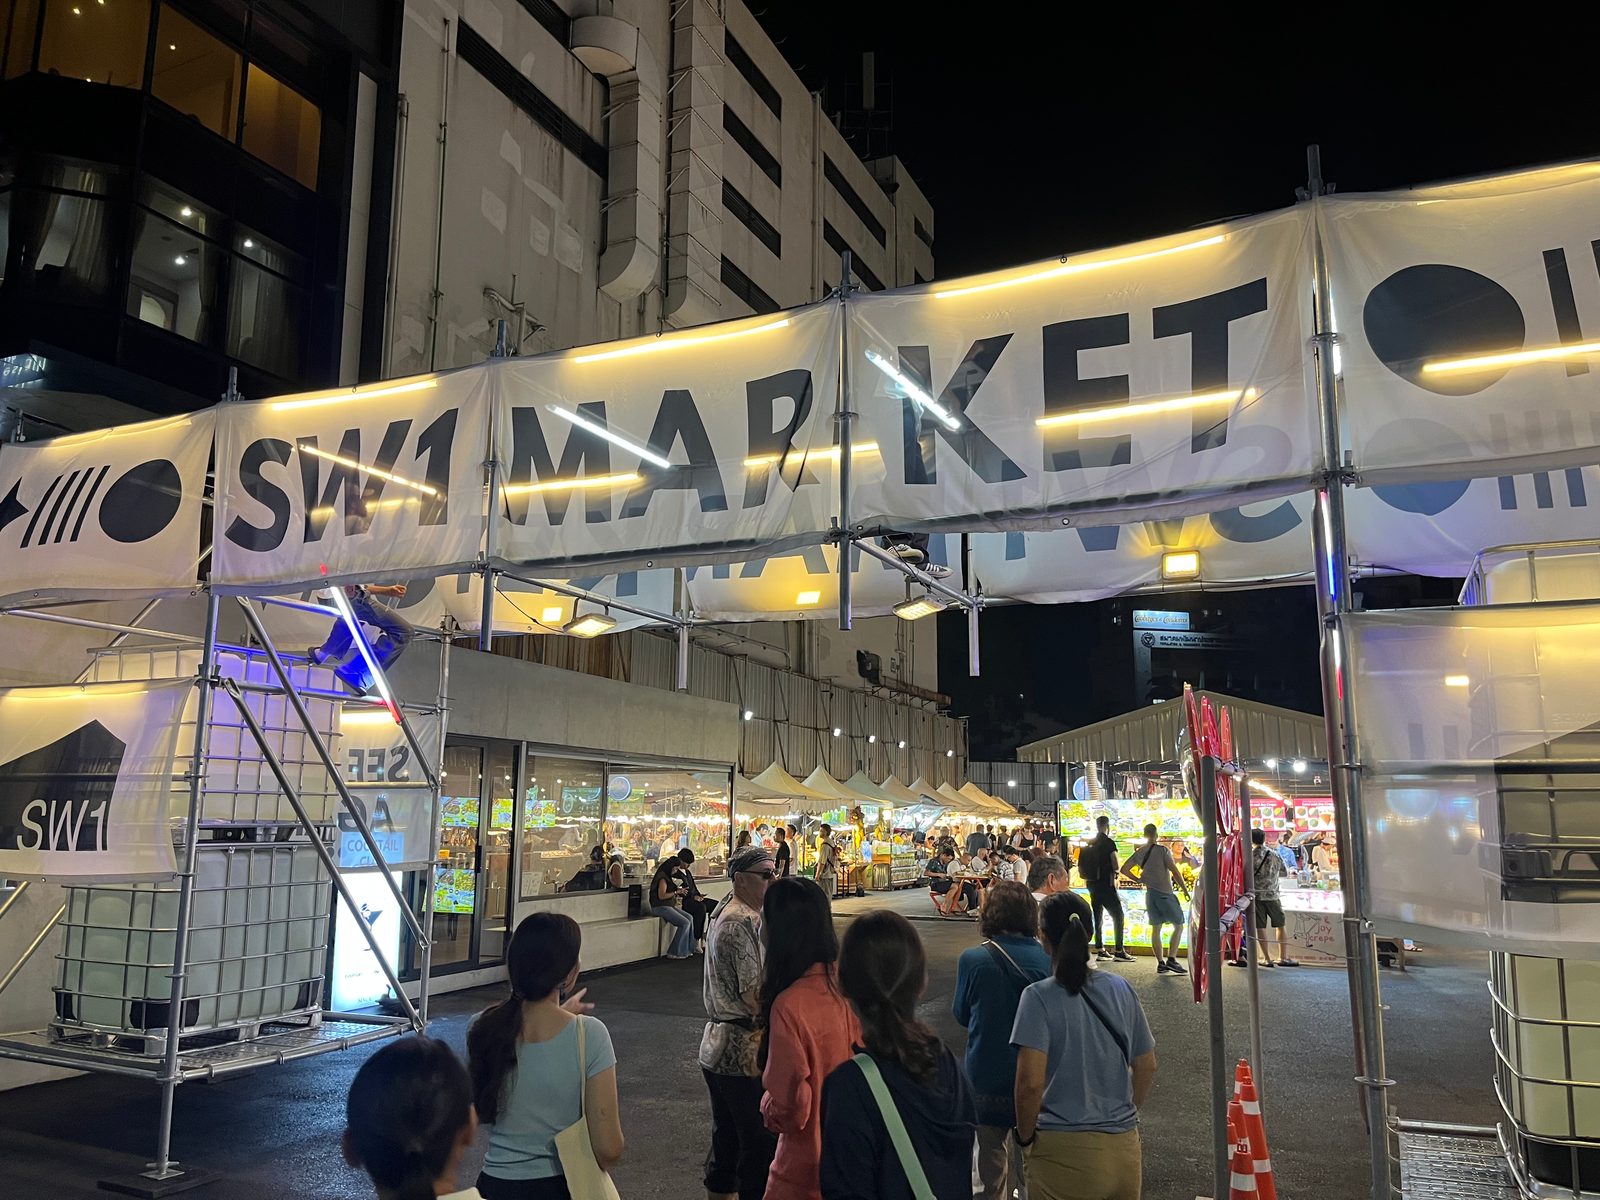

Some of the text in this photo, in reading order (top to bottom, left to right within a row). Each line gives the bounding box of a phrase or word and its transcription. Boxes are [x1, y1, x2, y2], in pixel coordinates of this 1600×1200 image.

[225, 408, 458, 552] SW1
[16, 799, 107, 852] SW1
[347, 839, 398, 852] COCTAIL
